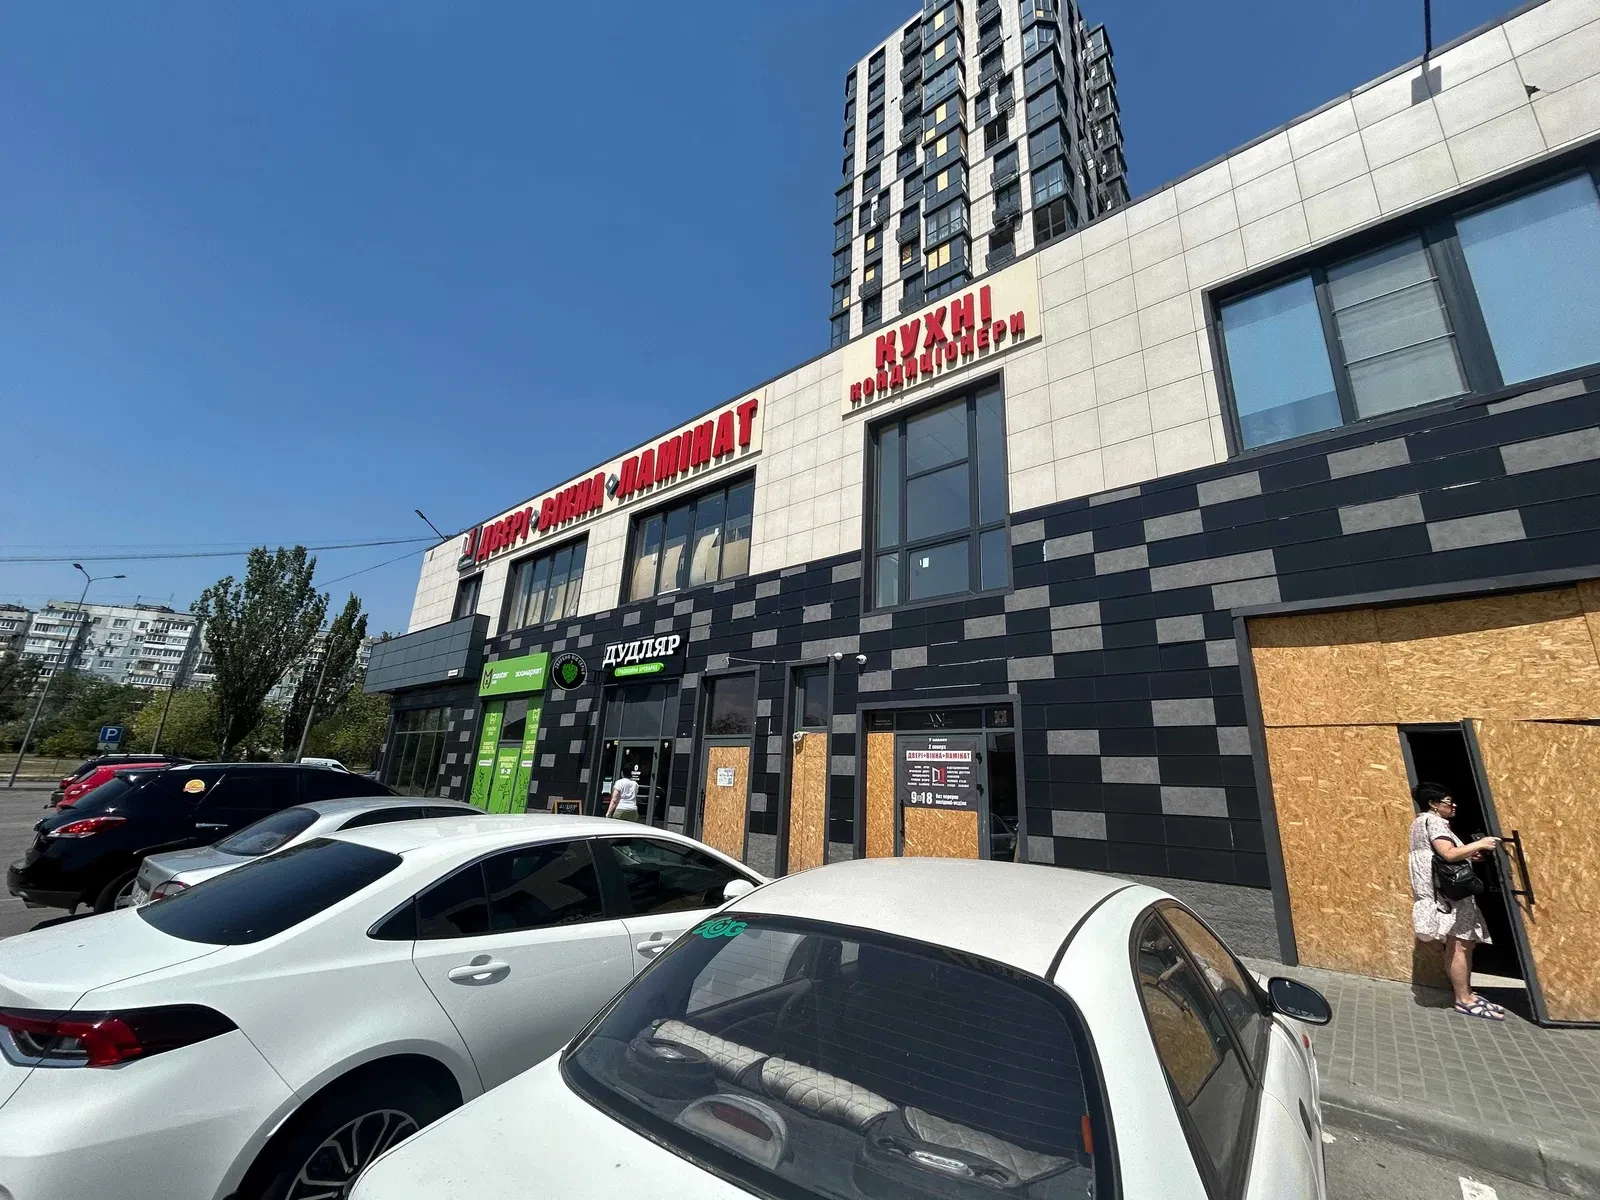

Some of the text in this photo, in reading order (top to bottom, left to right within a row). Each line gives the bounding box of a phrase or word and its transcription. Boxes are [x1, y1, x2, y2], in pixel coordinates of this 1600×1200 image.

[850, 310, 1025, 403] КОНДИЦІОНЕРИ
[875, 284, 992, 370] КУХНІ
[476, 398, 758, 562] ДВЕРІ ВІКНА ЛАМІНАТ
[602, 634, 681, 670] ДУДЛЯР
